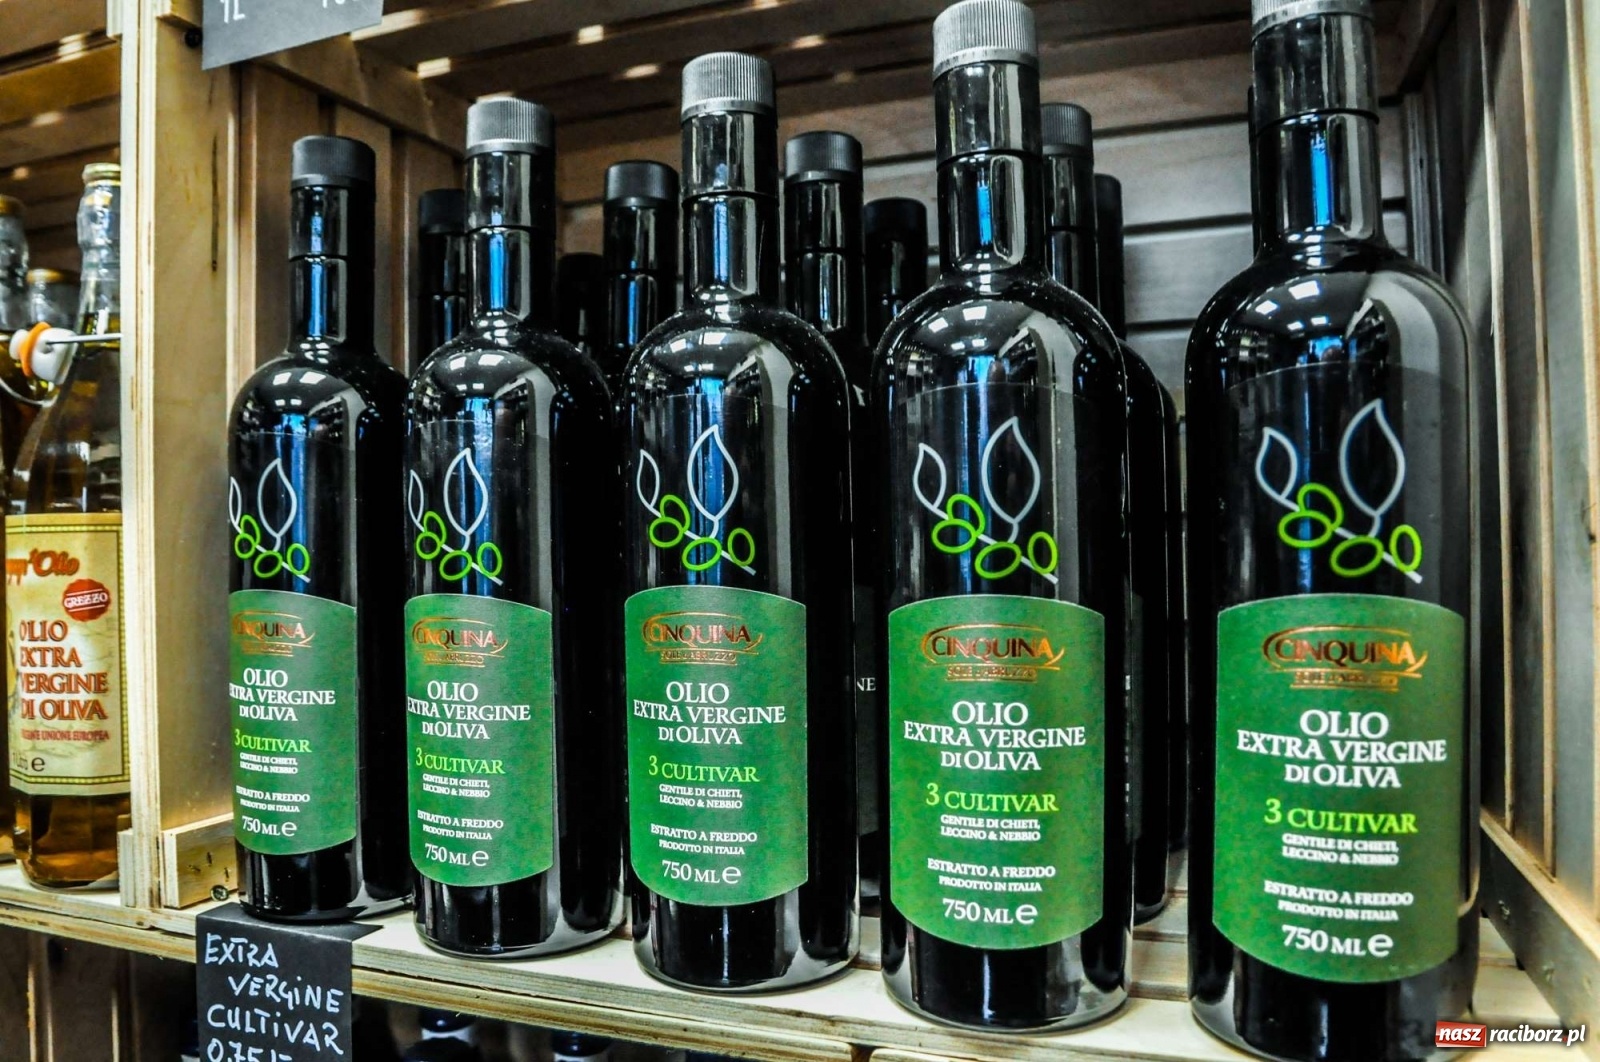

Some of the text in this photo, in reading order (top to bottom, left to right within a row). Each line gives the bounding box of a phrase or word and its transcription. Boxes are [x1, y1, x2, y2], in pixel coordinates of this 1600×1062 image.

[648, 623, 751, 647] CINQUINA
[931, 636, 1054, 663] CINQUINA
[1274, 639, 1416, 666] CINQUINA
[243, 668, 289, 688] OLIO
[256, 688, 336, 705] VERGINE
[427, 680, 479, 702] OLIO
[666, 681, 729, 704] OLIO
[39, 698, 108, 721] OLIVA
[239, 704, 298, 721] DI OLIVA
[407, 696, 531, 721] EXTRA VERGINE
[633, 699, 786, 725] EXTRA VERGINE
[952, 700, 1028, 726] OLIO
[422, 720, 490, 740] DI OLIVA
[904, 720, 1086, 748] EXTRA VERGINE
[1300, 709, 1389, 738] OLIO
[234, 728, 313, 753] 3 CULTIVAR
[658, 726, 743, 745] DI OLIVA
[1237, 730, 1447, 763] EXTRA VERGINE
[416, 747, 506, 774] 3 CULTIVAR
[649, 755, 760, 782] 3 CULTIVAR
[940, 750, 1041, 771] DI OLIVA
[1284, 764, 1401, 788] DI OLIVA
[659, 783, 694, 796] GENTILE
[695, 787, 705, 797] DI
[660, 794, 743, 809] LECCINO & NEBBIO
[926, 782, 1059, 812] 3 CULTIVAR
[242, 815, 260, 833] 750
[261, 823, 281, 836] ML
[940, 814, 984, 828] GENTILE
[986, 818, 999, 828] DI
[1264, 799, 1418, 833] 3 CULTIVAR
[651, 823, 758, 842] ESTRATTO A FREDDO
[940, 826, 1041, 841] LECCINO & NEBBIO
[1282, 834, 1336, 850] GENTILE
[1338, 839, 1352, 850] DI
[424, 843, 447, 862] 750
[449, 852, 471, 866] ML
[659, 839, 745, 855] PRODOTTO IN ITALIA
[1282, 846, 1398, 865] LECCINO & NEBBIO
[662, 860, 692, 881] 750
[694, 869, 720, 883] ML
[927, 858, 1056, 878] ESTRATTO A FREDDO
[938, 875, 1042, 892] PRODOTTO IN ITALIA
[1264, 880, 1414, 905] ESTRATTO A FREDDO
[942, 898, 981, 922] 750
[983, 908, 1014, 924] ML
[1278, 900, 1398, 921] PRODOTTO IN ITALIA
[204, 932, 279, 968] EXTRA
[1282, 925, 1329, 951] 750
[1331, 938, 1366, 956] ML
